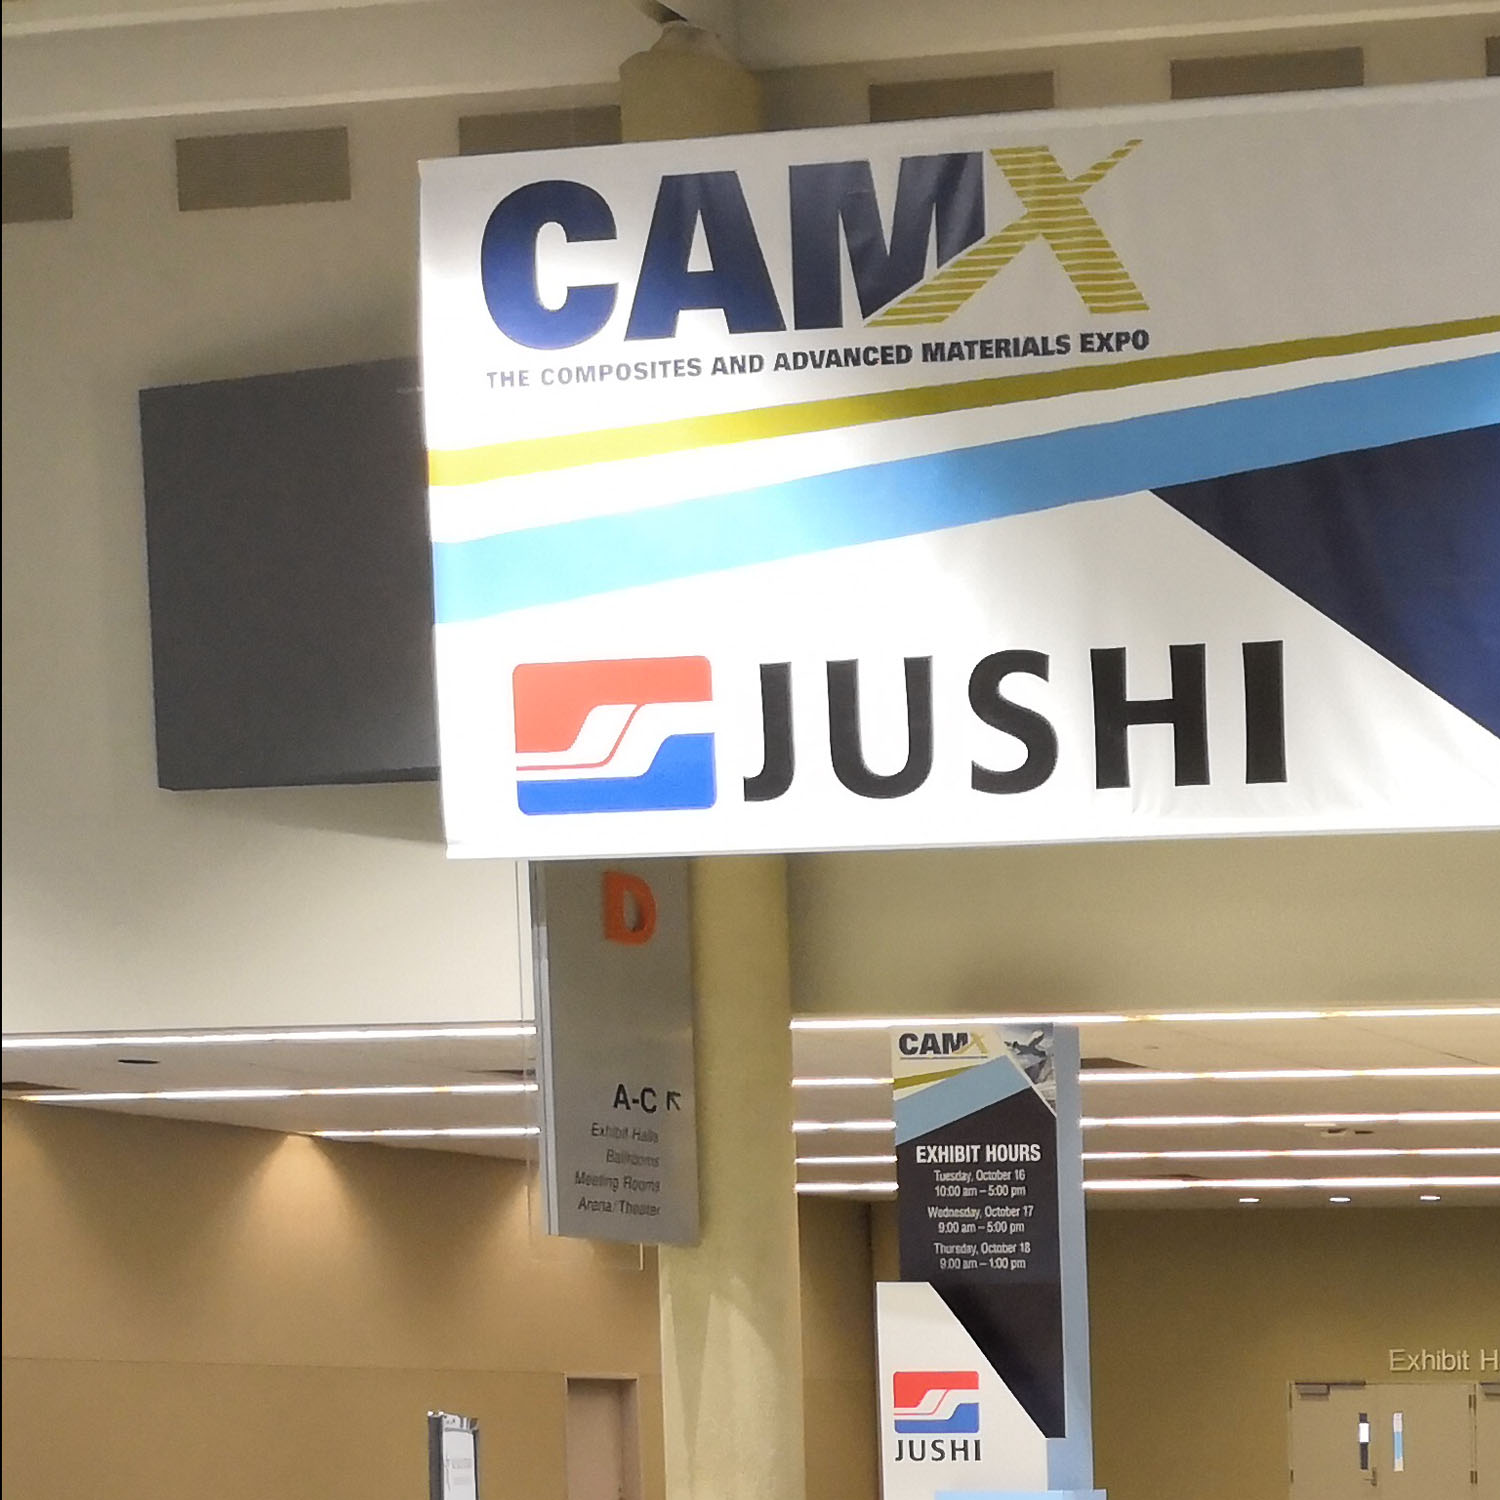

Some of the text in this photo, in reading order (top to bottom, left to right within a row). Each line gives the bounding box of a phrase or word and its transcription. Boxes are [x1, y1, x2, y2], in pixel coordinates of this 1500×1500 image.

[480, 138, 1151, 350] CAMX
[486, 328, 1150, 389] THE COMPOSITES AND ADVANCED MATERIALS EXPO
[742, 638, 1289, 803] JUSHI
[603, 870, 657, 947] D
[898, 1031, 989, 1056] CAMX
[613, 1083, 657, 1114] A-C
[915, 1143, 1042, 1164] EXHIBIT HOURS
[933, 1168, 1026, 1183] Tuesday, October 16
[934, 1185, 961, 1197] 10:00
[962, 1187, 978, 1197] am
[988, 1184, 1009, 1196] 5:00
[1011, 1186, 1026, 1198] pm
[927, 1205, 1034, 1220] Wednesday, October 17
[938, 1221, 959, 1234] 9:00
[961, 1224, 976, 1233] am
[987, 1221, 1008, 1233] 5:00
[1009, 1222, 1025, 1235] pm
[934, 1242, 1031, 1257] Thursday, October 18
[940, 1258, 961, 1270] 9:00
[962, 1260, 978, 1270] am
[989, 1258, 1009, 1270] 1:00
[1011, 1259, 1026, 1271] pm
[1388, 1348, 1470, 1372] Exhibit
[895, 1439, 982, 1461] JUSHI
